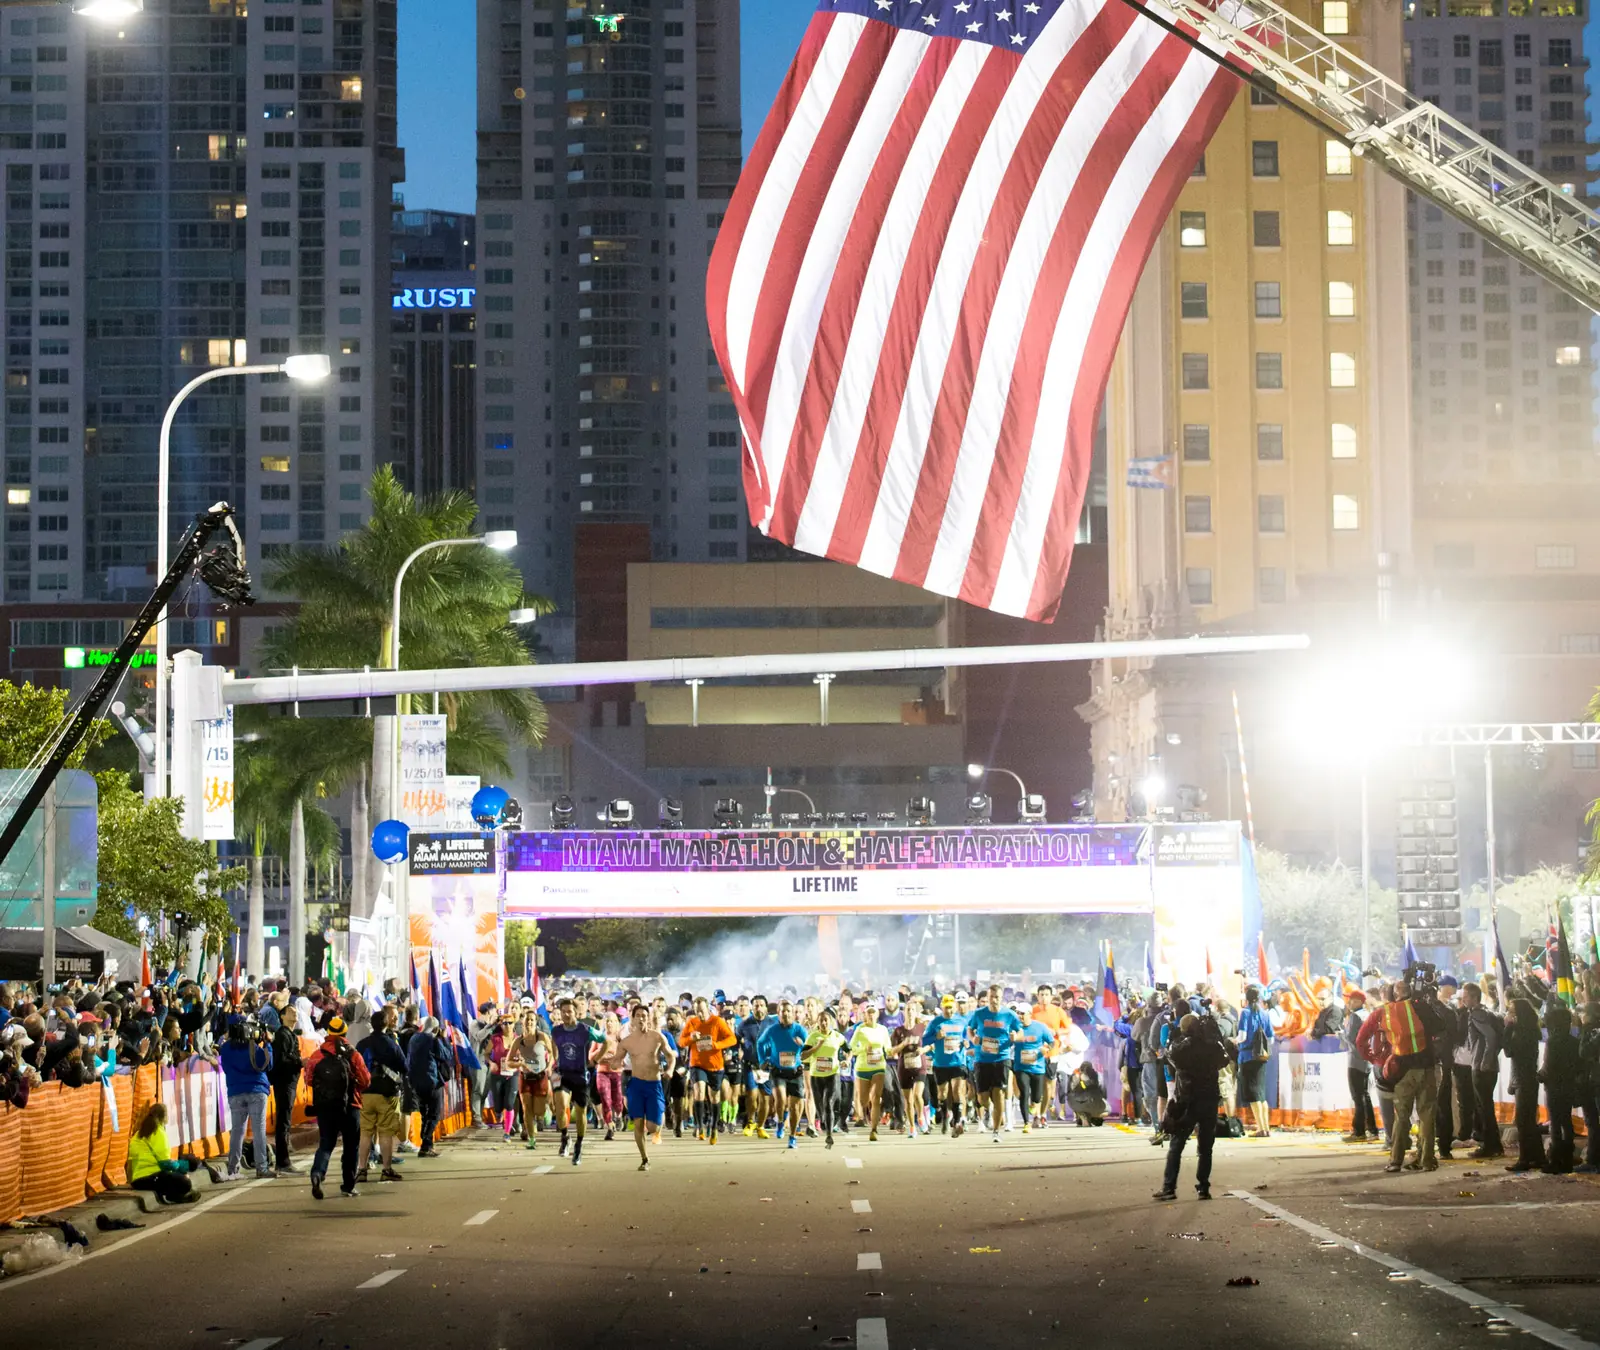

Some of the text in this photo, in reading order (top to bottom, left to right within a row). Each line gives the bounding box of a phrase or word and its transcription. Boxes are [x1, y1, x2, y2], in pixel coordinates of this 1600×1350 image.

[446, 839, 485, 851] LIFETIME
[562, 833, 1091, 867] MIAMI MARATHON & HALF MARATHON
[413, 851, 489, 862] MIAMI MARATHON
[413, 862, 430, 870] AND
[431, 861, 448, 869] HALF
[792, 877, 858, 893] LIFETIME
[40, 957, 91, 971] LETIME
